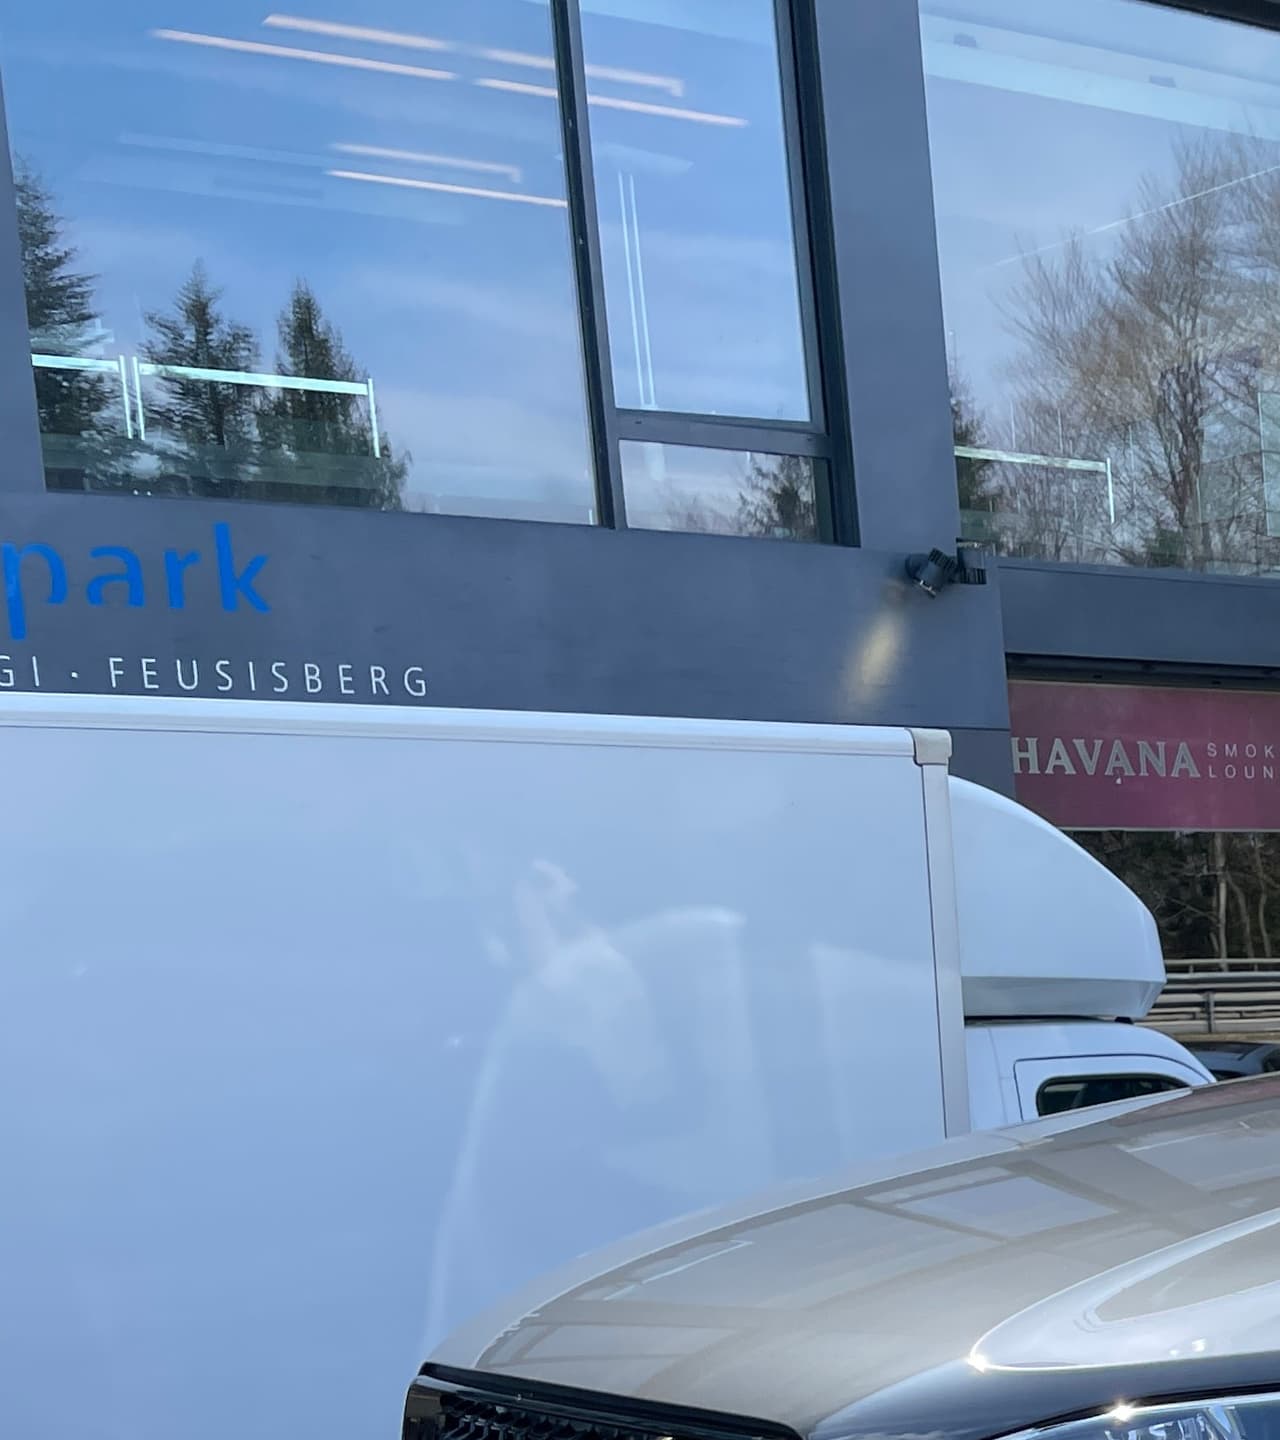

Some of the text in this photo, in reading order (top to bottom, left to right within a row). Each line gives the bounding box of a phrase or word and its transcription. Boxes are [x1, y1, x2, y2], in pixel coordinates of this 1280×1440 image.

[0, 521, 271, 640] park
[108, 656, 428, 698] FEUSISBERG
[1011, 736, 1200, 778] HAVANA
